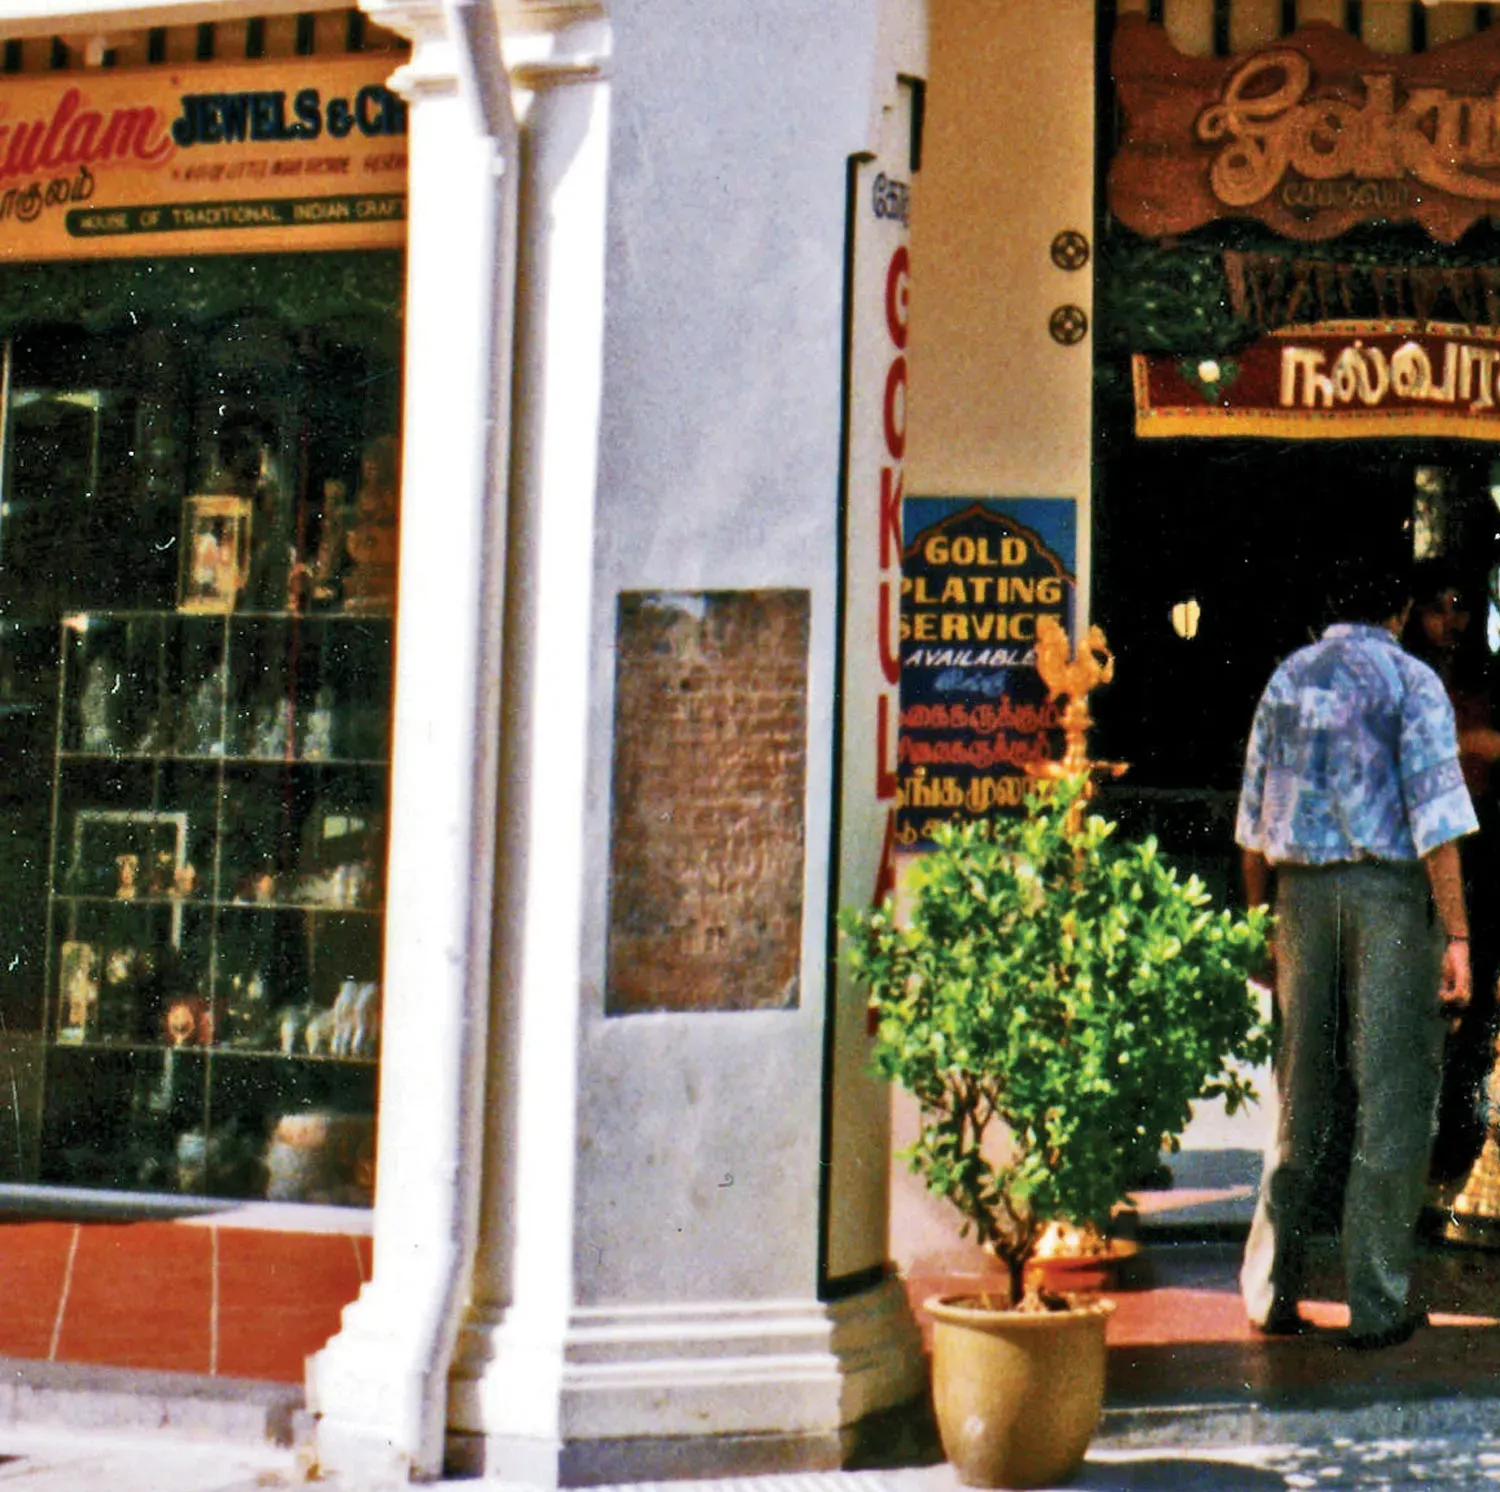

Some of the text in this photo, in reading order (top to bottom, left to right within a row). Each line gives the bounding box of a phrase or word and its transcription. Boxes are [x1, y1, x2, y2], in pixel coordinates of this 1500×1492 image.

[171, 88, 321, 148] JEWELS
[171, 206, 283, 226] TRADITIONAL
[924, 535, 1028, 566] GOLD
[900, 613, 1060, 642] SERVIC
[904, 648, 1037, 667] AVAILABLE
